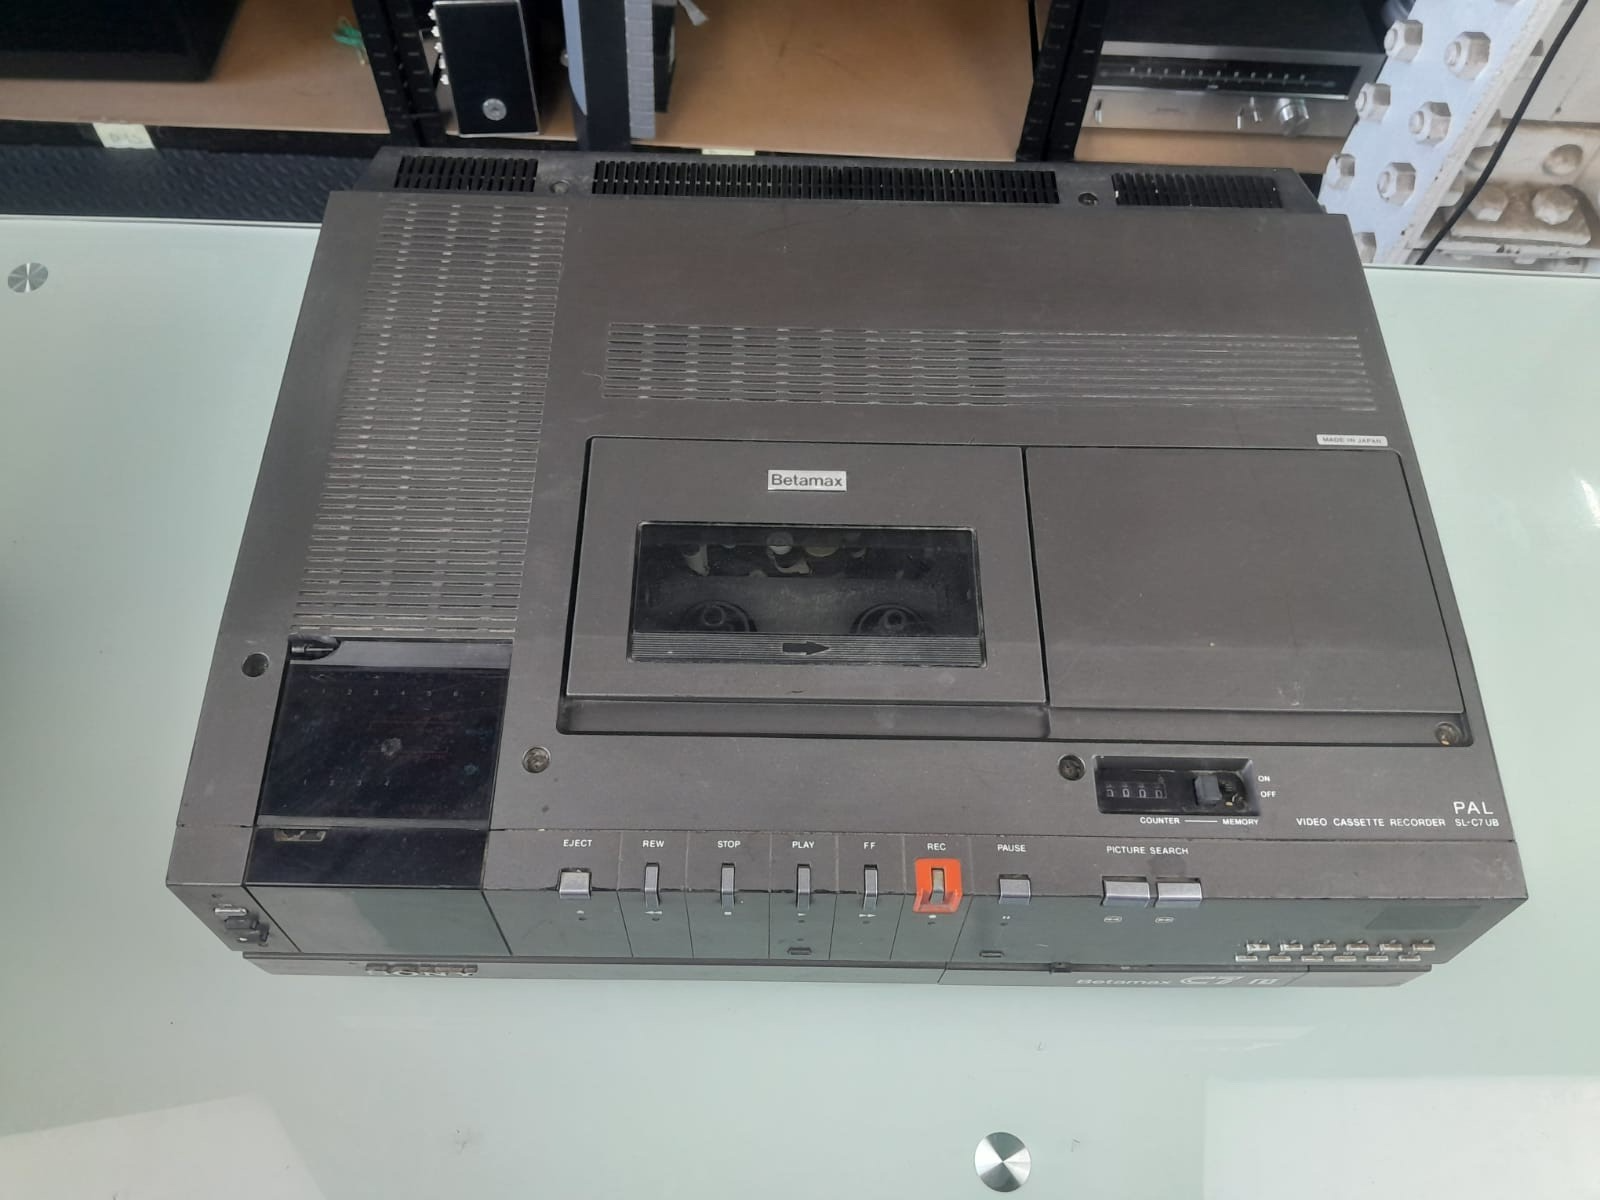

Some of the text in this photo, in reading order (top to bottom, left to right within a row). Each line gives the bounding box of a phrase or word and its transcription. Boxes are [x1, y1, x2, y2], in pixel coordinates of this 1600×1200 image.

[771, 473, 843, 487] Betamax
[1260, 790, 1277, 798] OFF
[1453, 801, 1494, 815] PAL
[1139, 817, 1180, 825] COUNTER
[1222, 818, 1259, 826] MEMORY
[1296, 817, 1446, 827] VIDEO CASSETTE RECORDER
[563, 839, 593, 847] EJECT
[642, 839, 665, 848] REW
[717, 840, 741, 848] STOP
[791, 840, 815, 849] PLAY
[926, 842, 947, 851] REC
[996, 843, 1027, 852] PAUSE
[1106, 845, 1189, 855] PICTURE SEARCH
